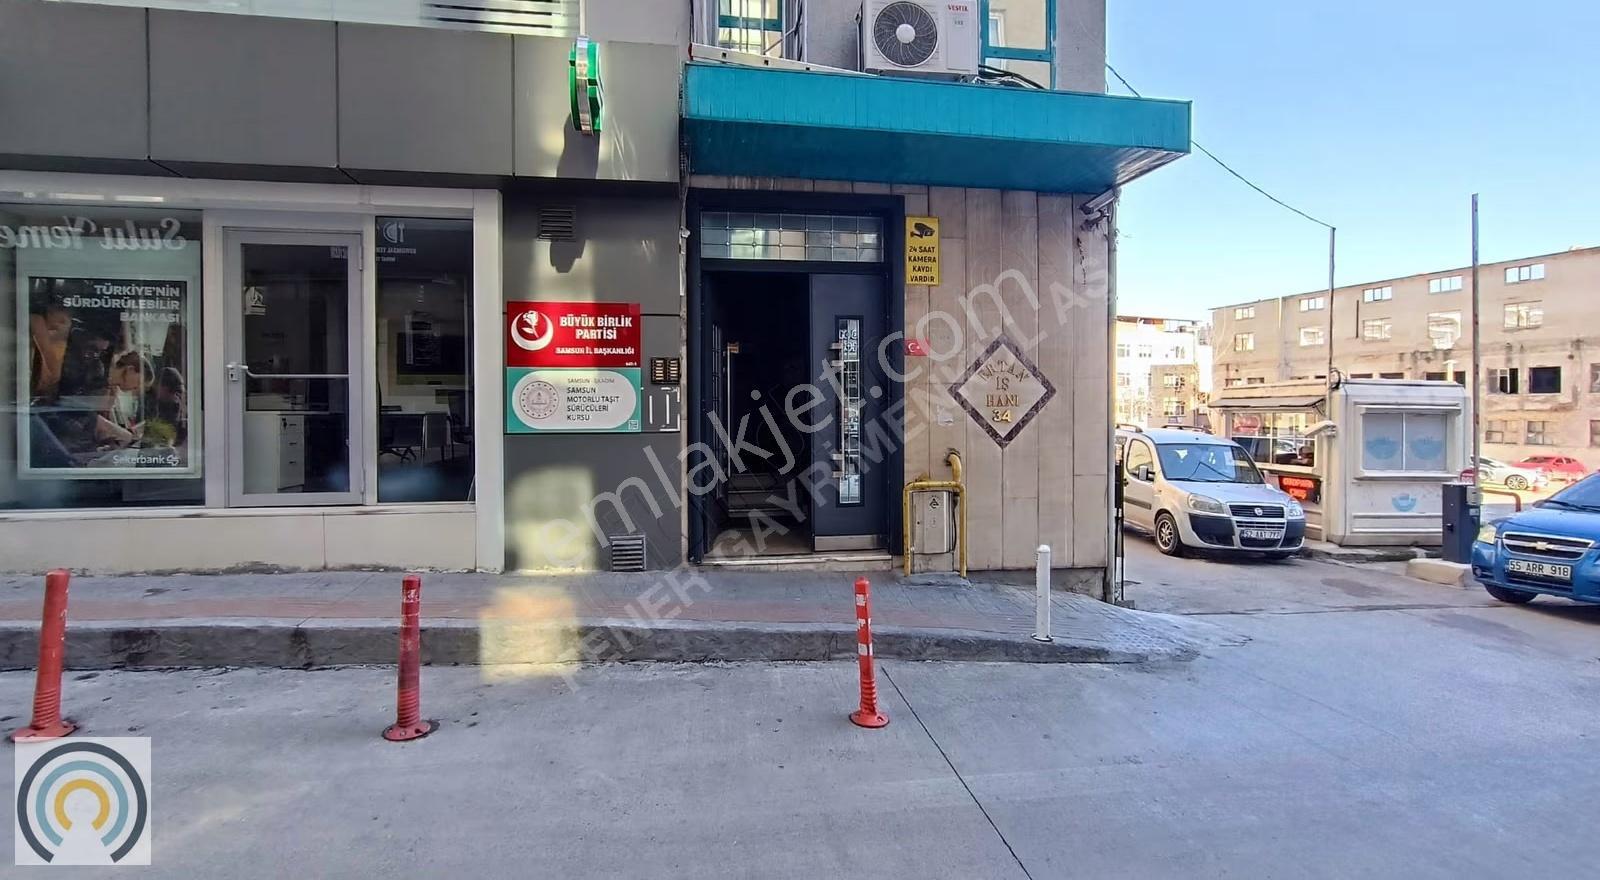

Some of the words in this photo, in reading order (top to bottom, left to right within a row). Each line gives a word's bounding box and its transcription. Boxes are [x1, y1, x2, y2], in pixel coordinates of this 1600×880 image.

[908, 255, 937, 263] KAMERA
[912, 265, 933, 273] KAYDI
[93, 282, 180, 297] TÜRKİYE'NİN
[62, 295, 180, 310] SÜRDÜRÜLEBİLİR
[119, 311, 180, 323] BANKASI
[559, 314, 596, 327] BÜYÜK
[597, 315, 633, 327] BİRLİK
[575, 327, 617, 340] PARTİSİ
[593, 346, 635, 355] BAŞKANLIĞI
[567, 395, 600, 403] MOTORLU
[601, 395, 620, 404] TAŞIT
[985, 394, 1019, 408] HANI
[991, 408, 1011, 423] 34
[1510, 561, 1521, 570] 55
[1526, 563, 1544, 574] ARR
[1550, 566, 1569, 577] 918
